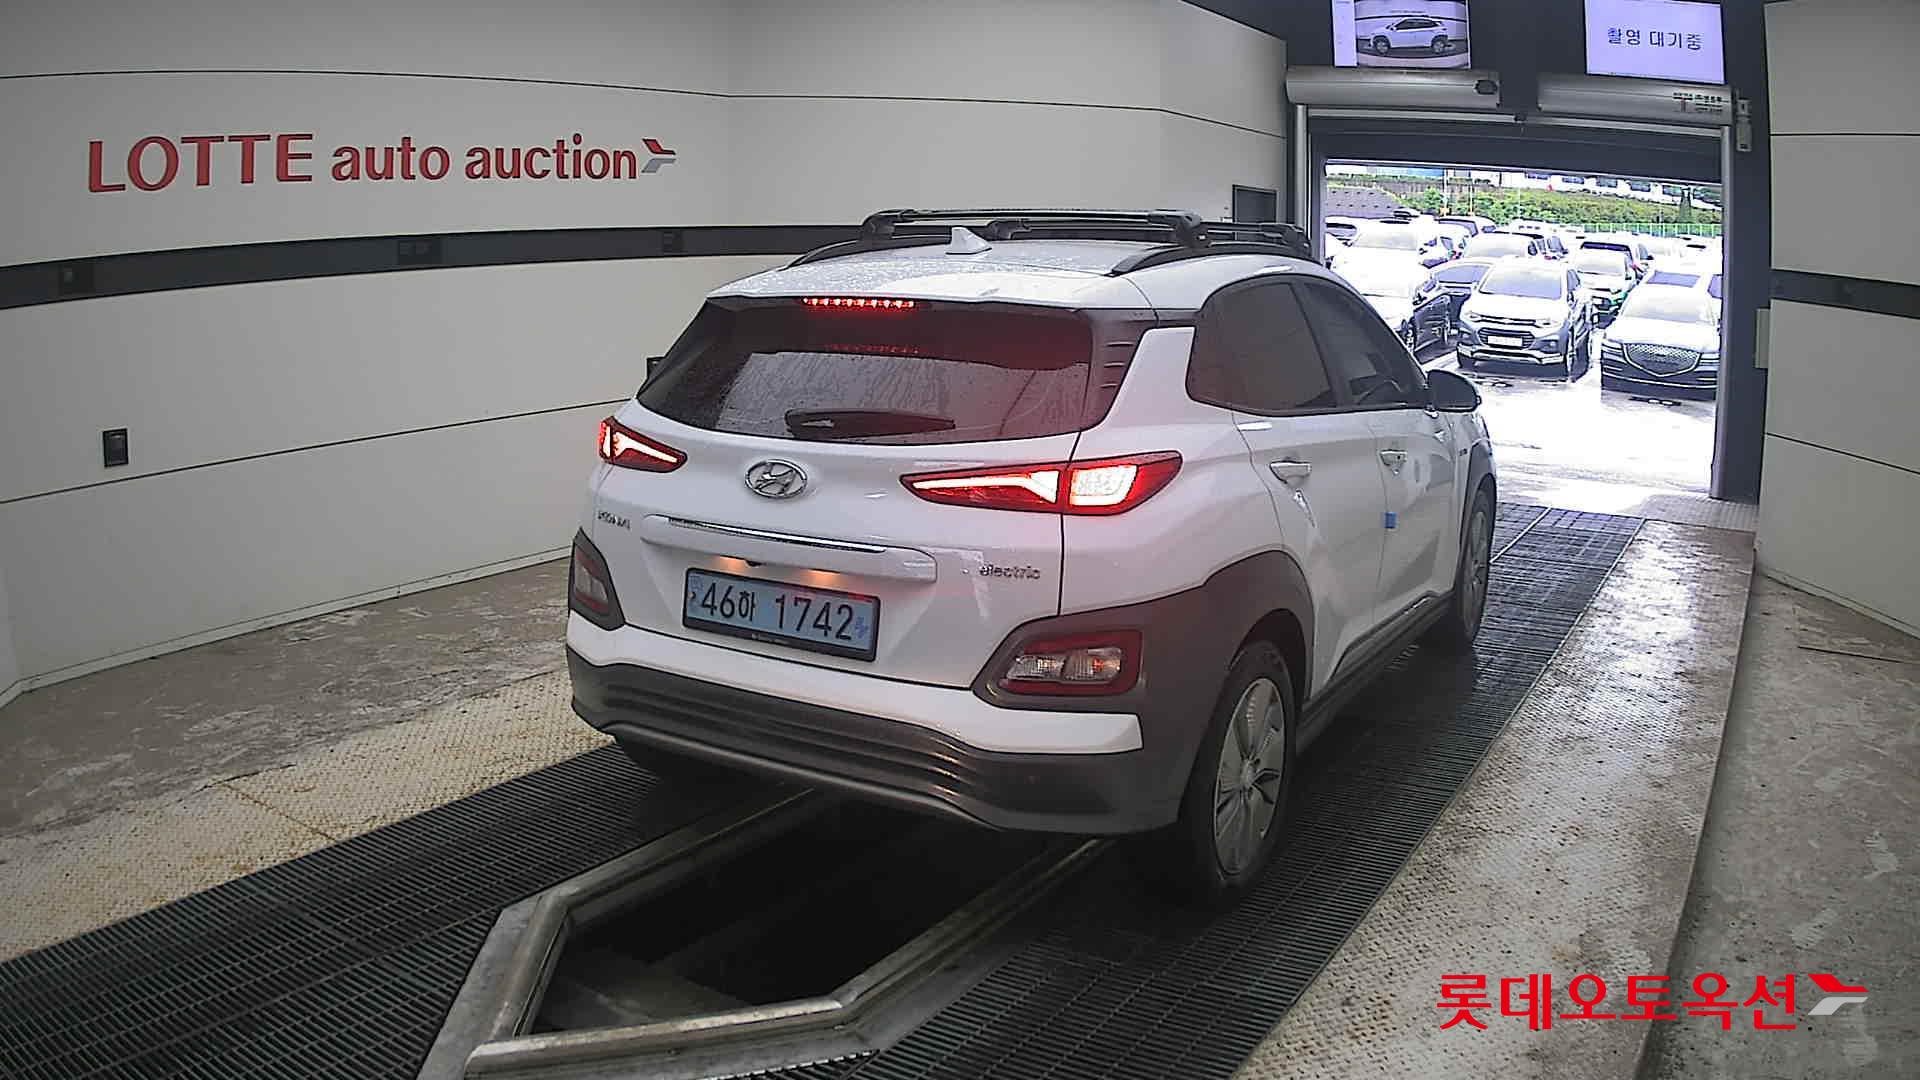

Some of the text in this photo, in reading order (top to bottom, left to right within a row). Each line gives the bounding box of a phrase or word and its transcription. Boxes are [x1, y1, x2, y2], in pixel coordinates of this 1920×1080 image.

[89, 133, 637, 193] LOTTE auto auction
[979, 563, 1041, 580] electric
[701, 582, 854, 640] 46하 1742
